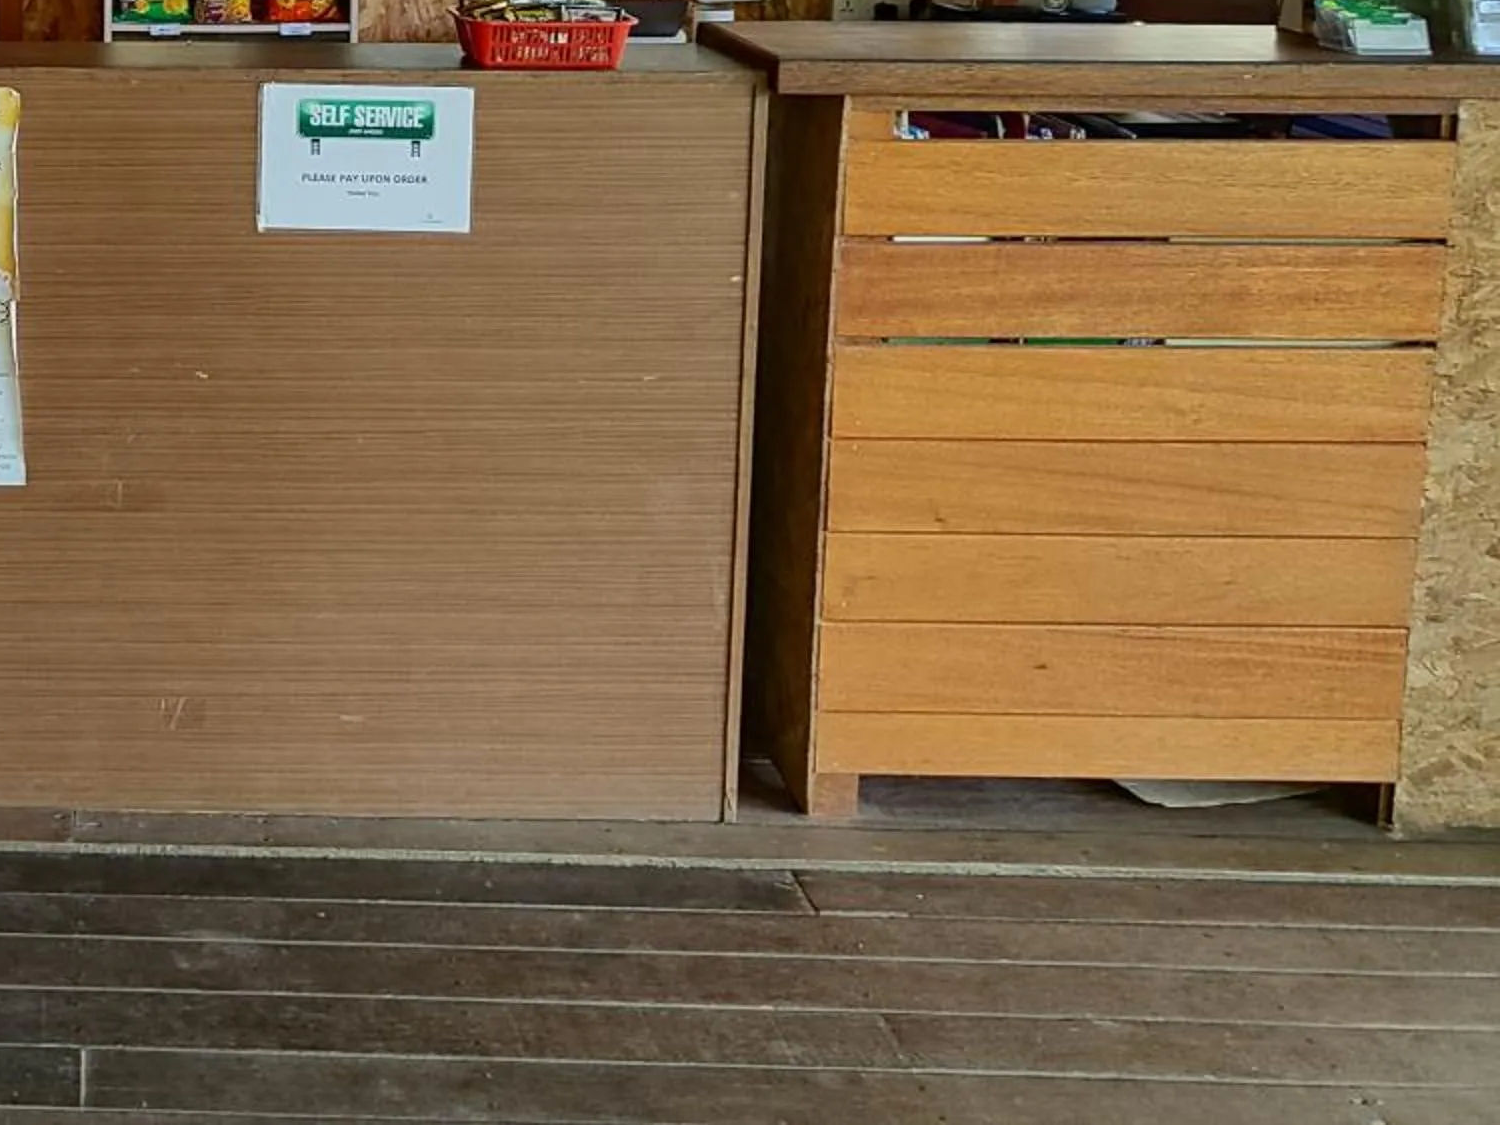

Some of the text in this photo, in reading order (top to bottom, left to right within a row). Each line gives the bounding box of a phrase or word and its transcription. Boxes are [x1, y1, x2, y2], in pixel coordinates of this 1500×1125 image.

[309, 104, 424, 128] SELF SERVICE
[301, 173, 428, 184] PLEASE PAY UPON ORDER
